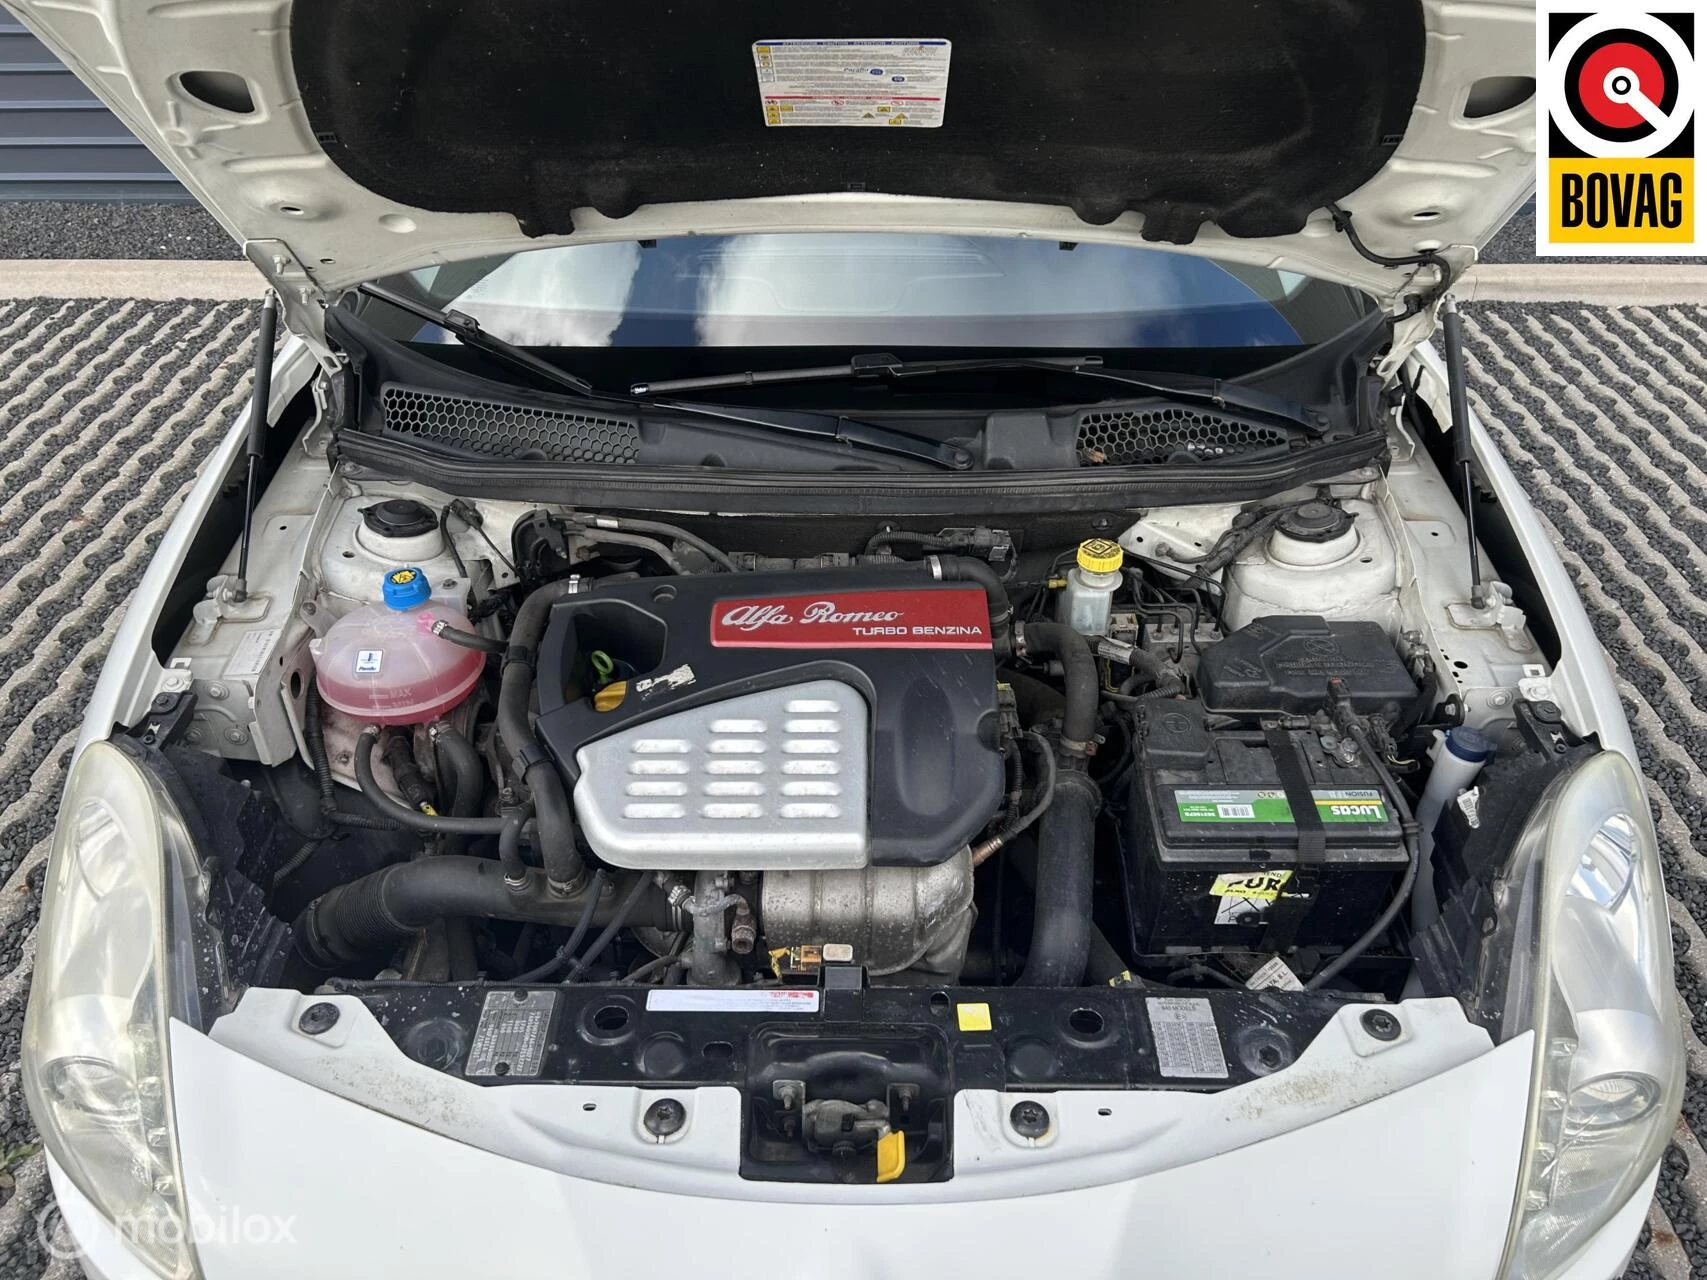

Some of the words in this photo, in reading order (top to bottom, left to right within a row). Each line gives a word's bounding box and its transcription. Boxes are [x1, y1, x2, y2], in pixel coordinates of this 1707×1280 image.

[721, 605, 793, 631] Alfa
[800, 601, 904, 625] Romeo
[852, 626, 908, 636] TURBO
[911, 626, 983, 635] BENZINA
[390, 688, 412, 698] MAX
[1344, 791, 1374, 799] FUSION
[1331, 805, 1382, 819] Lucas
